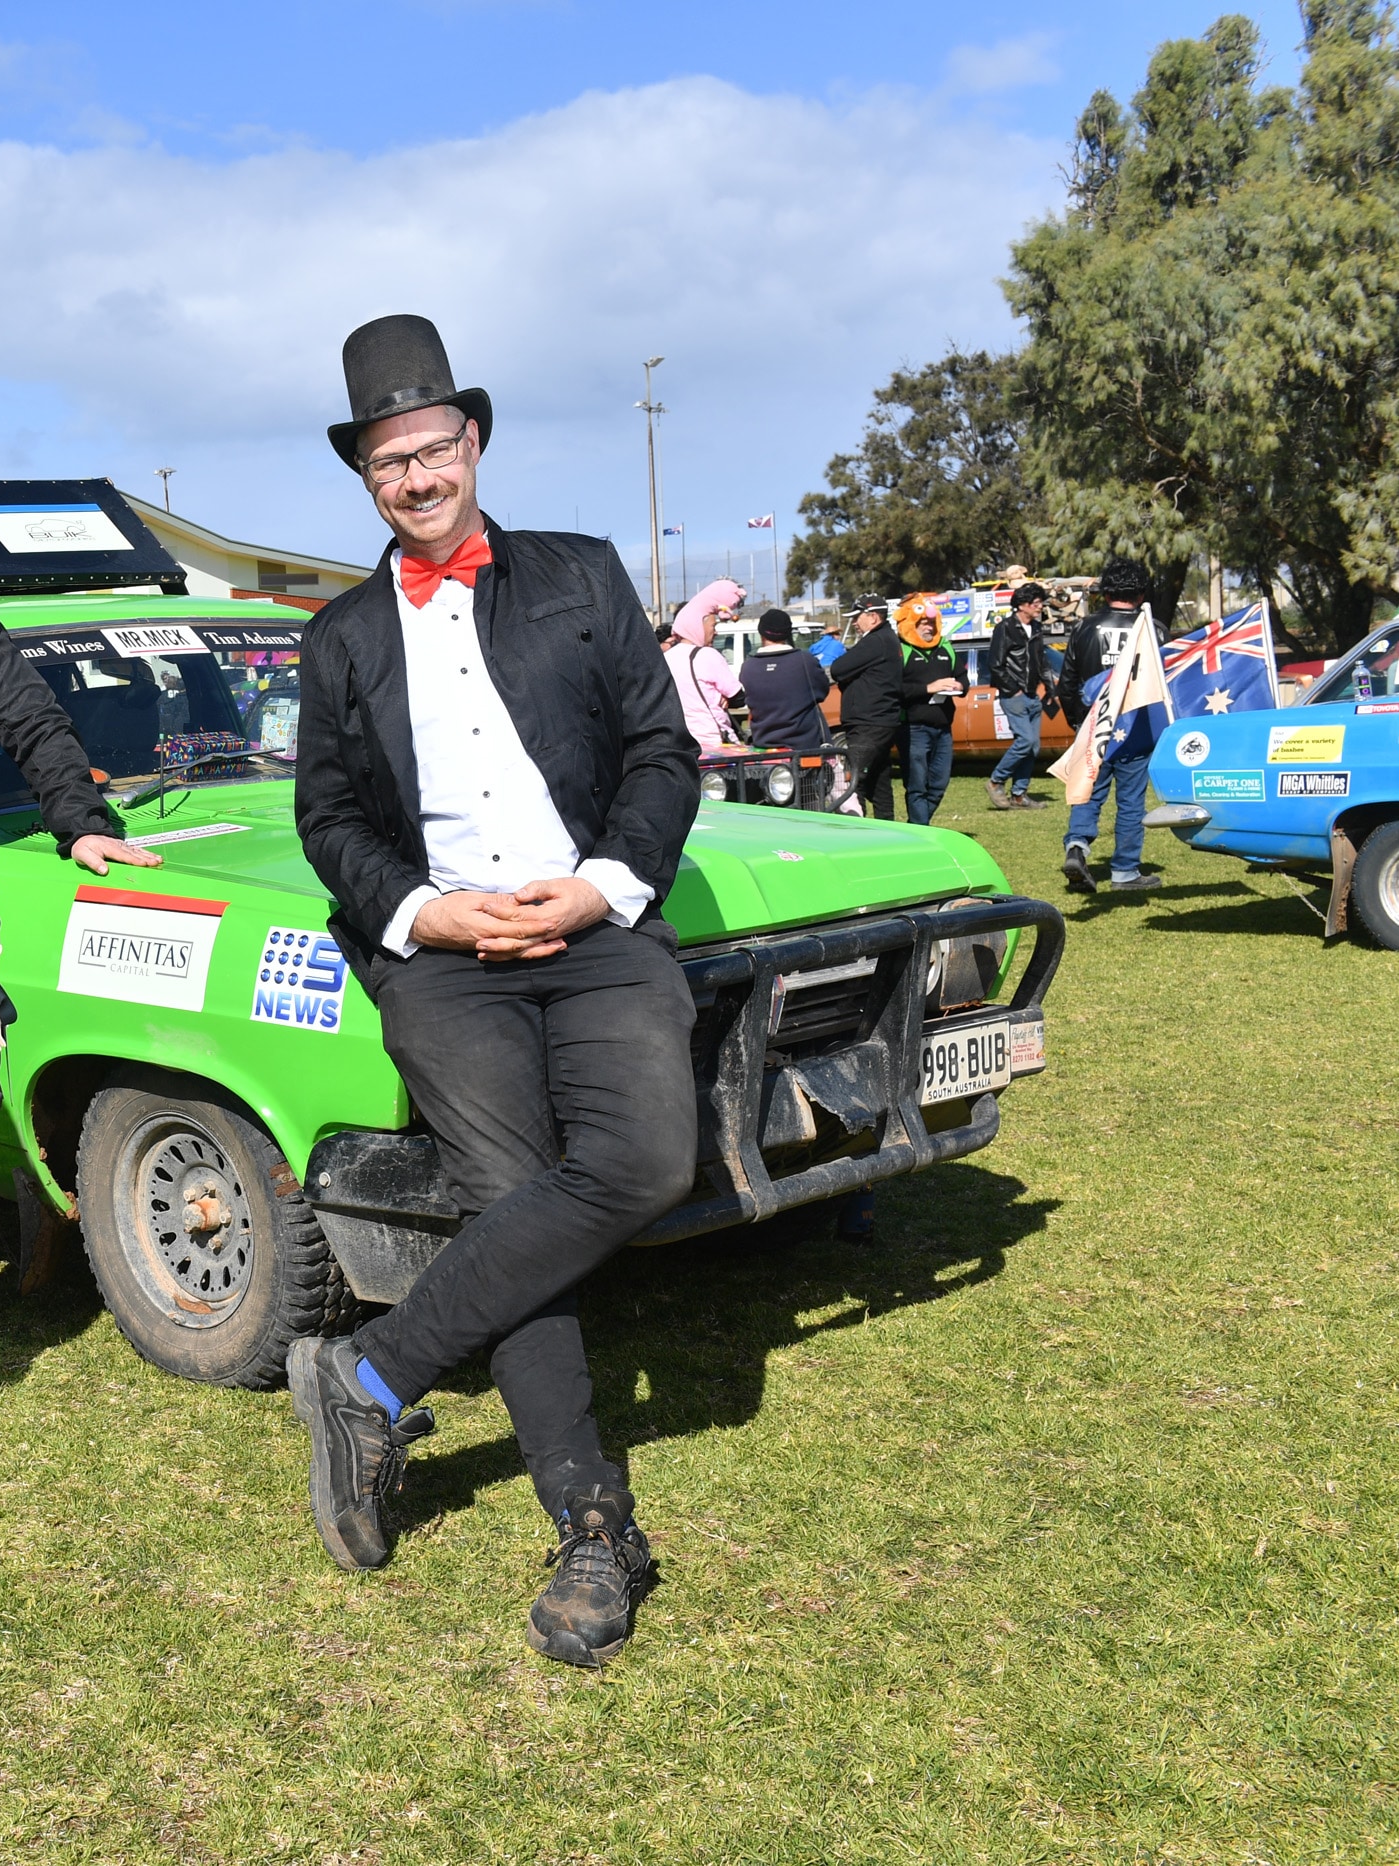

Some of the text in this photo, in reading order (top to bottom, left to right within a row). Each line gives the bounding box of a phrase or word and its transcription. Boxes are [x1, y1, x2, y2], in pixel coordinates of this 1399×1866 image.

[113, 628, 191, 648] MR.MICK
[203, 632, 242, 645] Tim
[245, 632, 294, 646] Adams
[20, 639, 105, 660] ms Wines
[1372, 703, 1399, 713] TOYOTA
[1203, 779, 1261, 787] CARPET ONE
[1282, 775, 1346, 790] MGA Whittles
[82, 934, 189, 969] AFFINITAS
[109, 963, 150, 977] CAPITAL
[302, 937, 346, 993] 9
[254, 989, 339, 1028] NEWS
[928, 1078, 992, 1101] SOUTH AUSTRALIA
